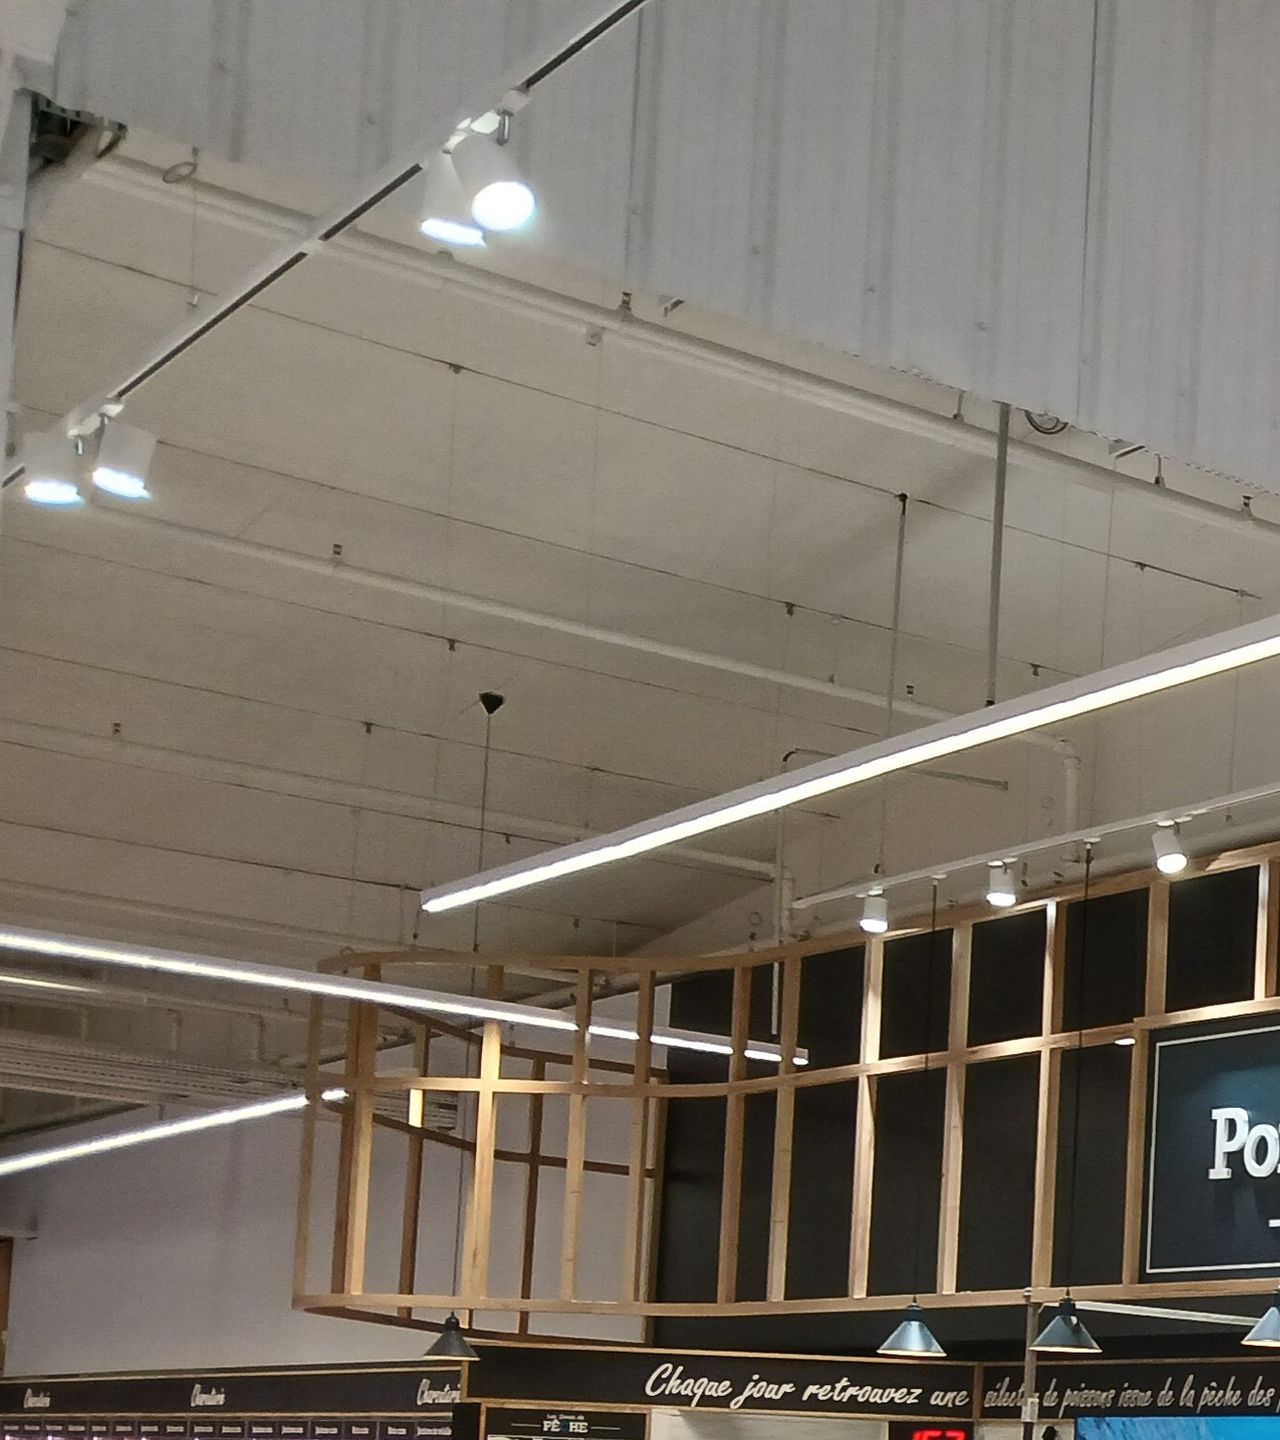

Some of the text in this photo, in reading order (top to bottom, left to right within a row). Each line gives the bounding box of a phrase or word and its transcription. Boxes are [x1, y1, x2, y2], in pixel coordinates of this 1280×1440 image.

[645, 1362, 732, 1408] Chaque
[730, 1373, 794, 1409] jour
[802, 1376, 919, 1405] retrouvez
[929, 1389, 968, 1408] une
[983, 1376, 1041, 1409] sélect
[1156, 1376, 1175, 1407] de
[1178, 1373, 1196, 1408] la
[1197, 1380, 1242, 1413] pêche
[1247, 1377, 1273, 1408] des
